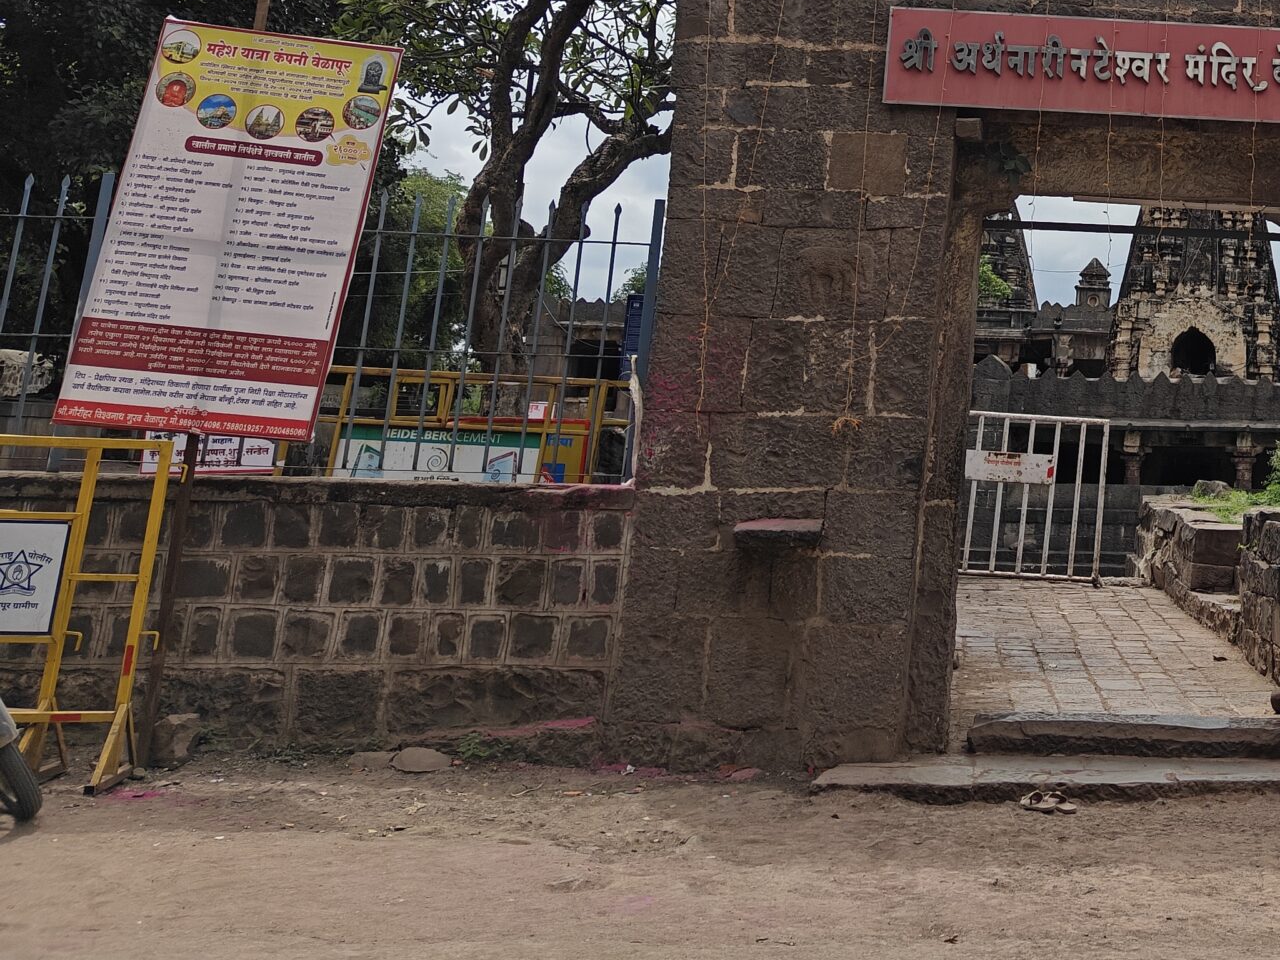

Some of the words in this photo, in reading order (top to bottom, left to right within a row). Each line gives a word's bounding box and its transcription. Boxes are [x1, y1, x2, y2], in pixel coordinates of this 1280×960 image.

[207, 40, 238, 57] महेश
[241, 47, 270, 61] यात्रा
[273, 48, 308, 65] कंपनी
[312, 53, 352, 75] वेळापूर
[900, 28, 937, 72] श्री
[144, 412, 168, 427] वेळापूर
[28, 550, 53, 564] पोलीस
[13, 601, 39, 610] ग्रामीण
